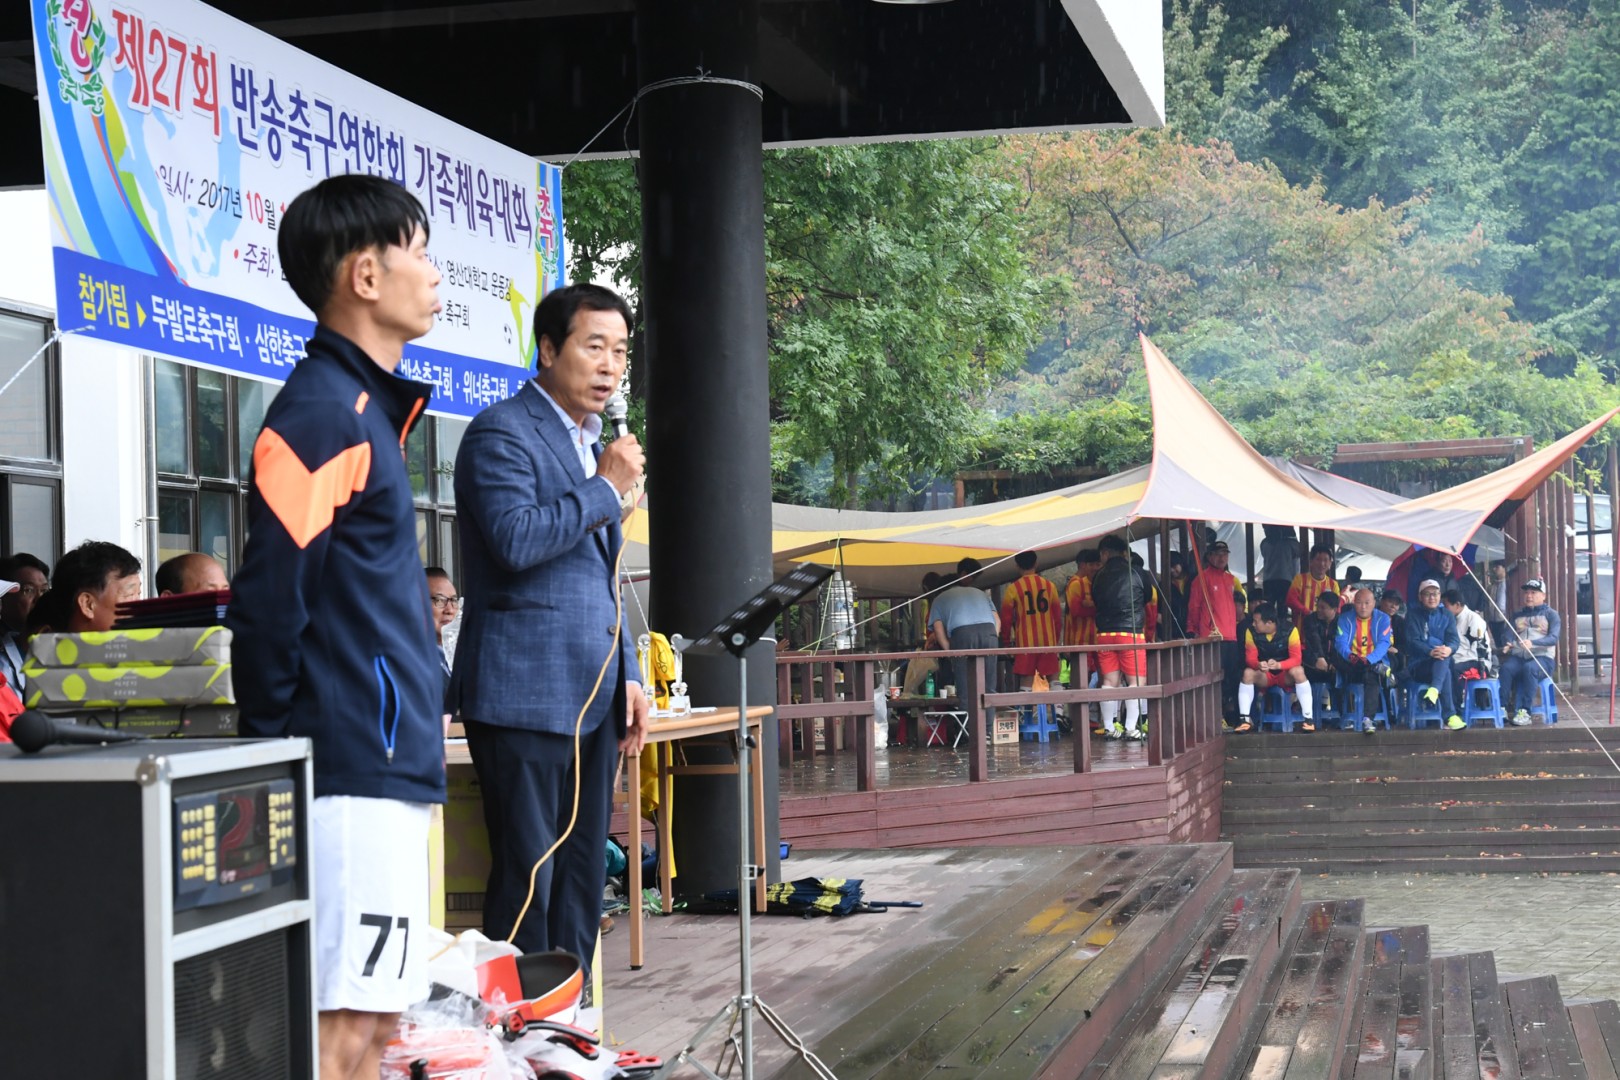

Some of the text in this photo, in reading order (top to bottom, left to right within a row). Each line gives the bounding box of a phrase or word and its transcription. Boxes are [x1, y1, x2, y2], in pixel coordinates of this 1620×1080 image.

[112, 9, 532, 249] 제27회 반송축구연합회 가족체육대회
[160, 164, 276, 231] 일시: 2017년 10월
[537, 189, 554, 250] 축
[243, 242, 275, 278] 주최:
[446, 260, 488, 292] 영산대학교
[491, 272, 512, 301] 운동장
[79, 272, 312, 368] 참가팀 두발로축구회 삼한축구
[1024, 589, 1049, 615] 16
[359, 912, 409, 980] 77
